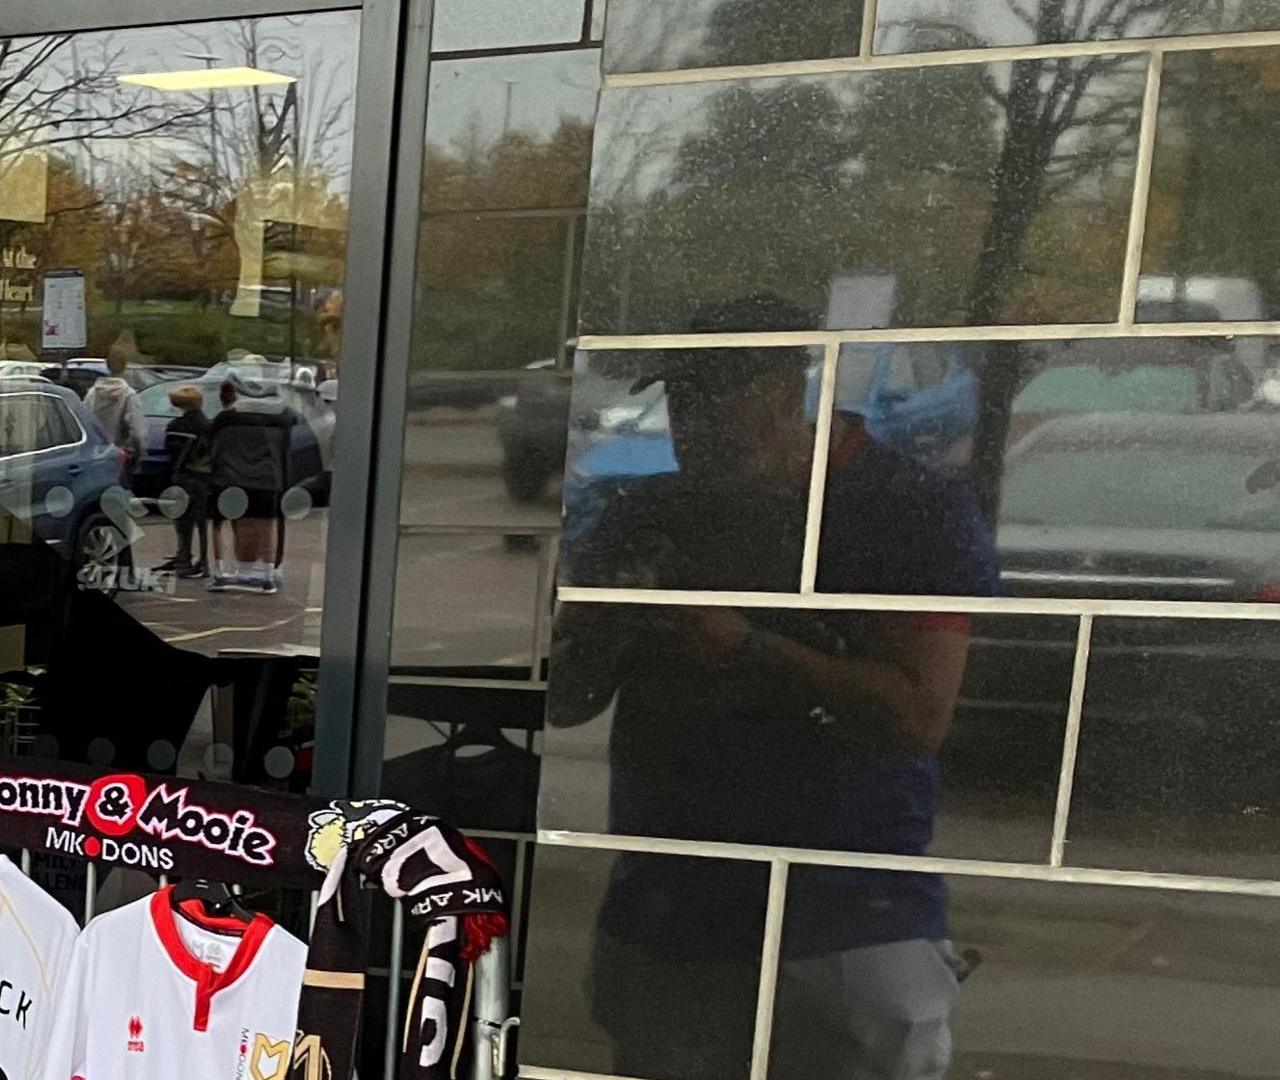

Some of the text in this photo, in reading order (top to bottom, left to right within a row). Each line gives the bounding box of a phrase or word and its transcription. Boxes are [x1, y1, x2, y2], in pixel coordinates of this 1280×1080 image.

[98, 782, 135, 824] &
[136, 783, 277, 866] Mooie
[101, 840, 175, 871] DONS
